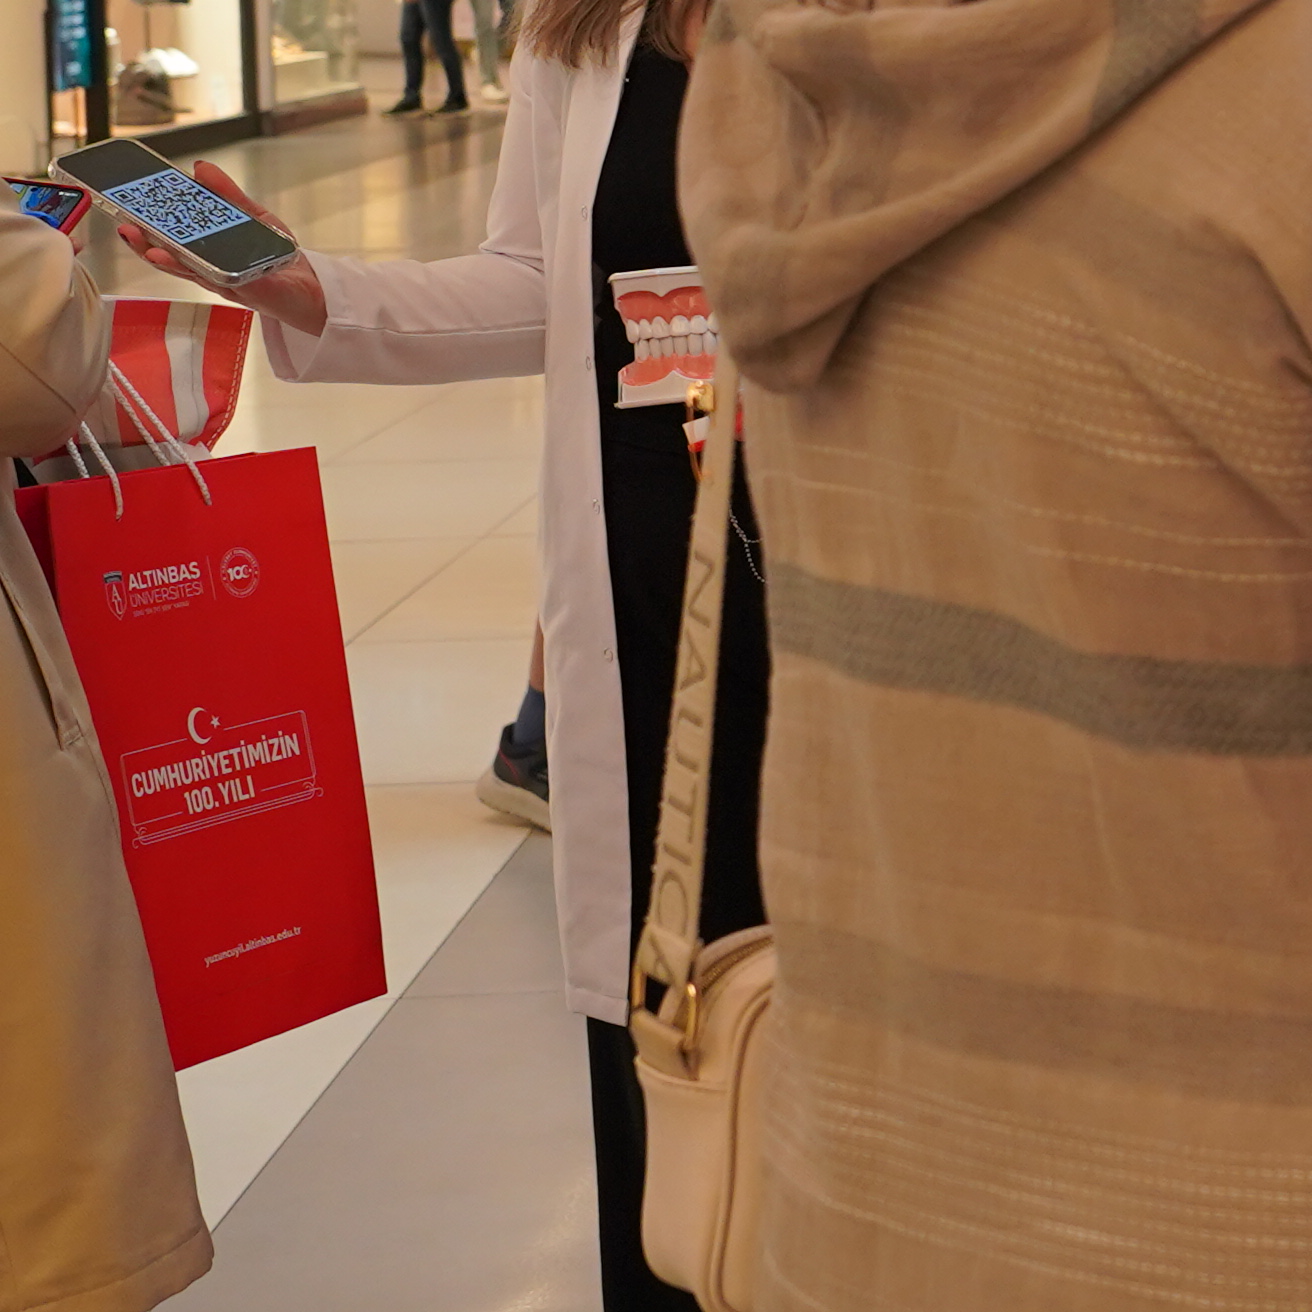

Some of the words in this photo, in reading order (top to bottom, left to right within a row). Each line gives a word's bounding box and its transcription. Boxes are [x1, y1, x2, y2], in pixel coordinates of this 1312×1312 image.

[131, 730, 301, 798] CUMHURİYETİMİZİN
[184, 786, 220, 815] 100.
[218, 775, 256, 805] YILI
